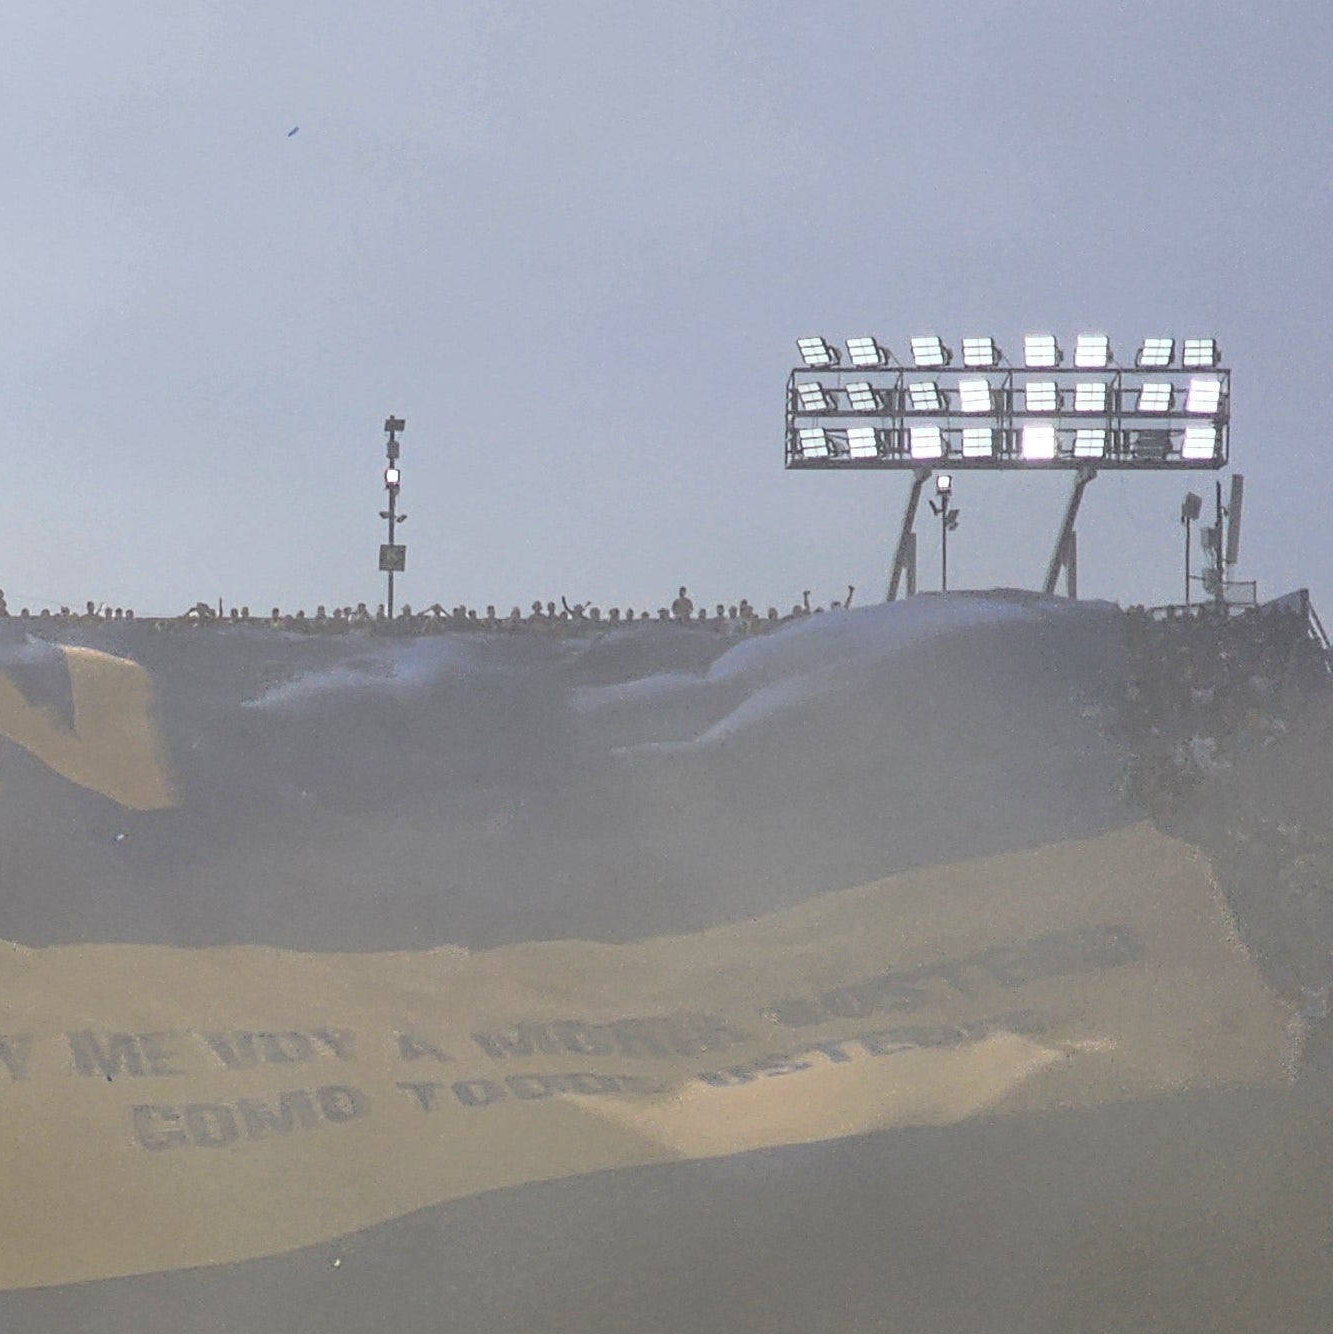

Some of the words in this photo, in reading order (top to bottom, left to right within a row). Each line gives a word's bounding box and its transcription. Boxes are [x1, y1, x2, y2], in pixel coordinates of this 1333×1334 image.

[65, 1026, 186, 1080] ME
[199, 1027, 357, 1071] VOY
[131, 1084, 373, 1152] COMO
